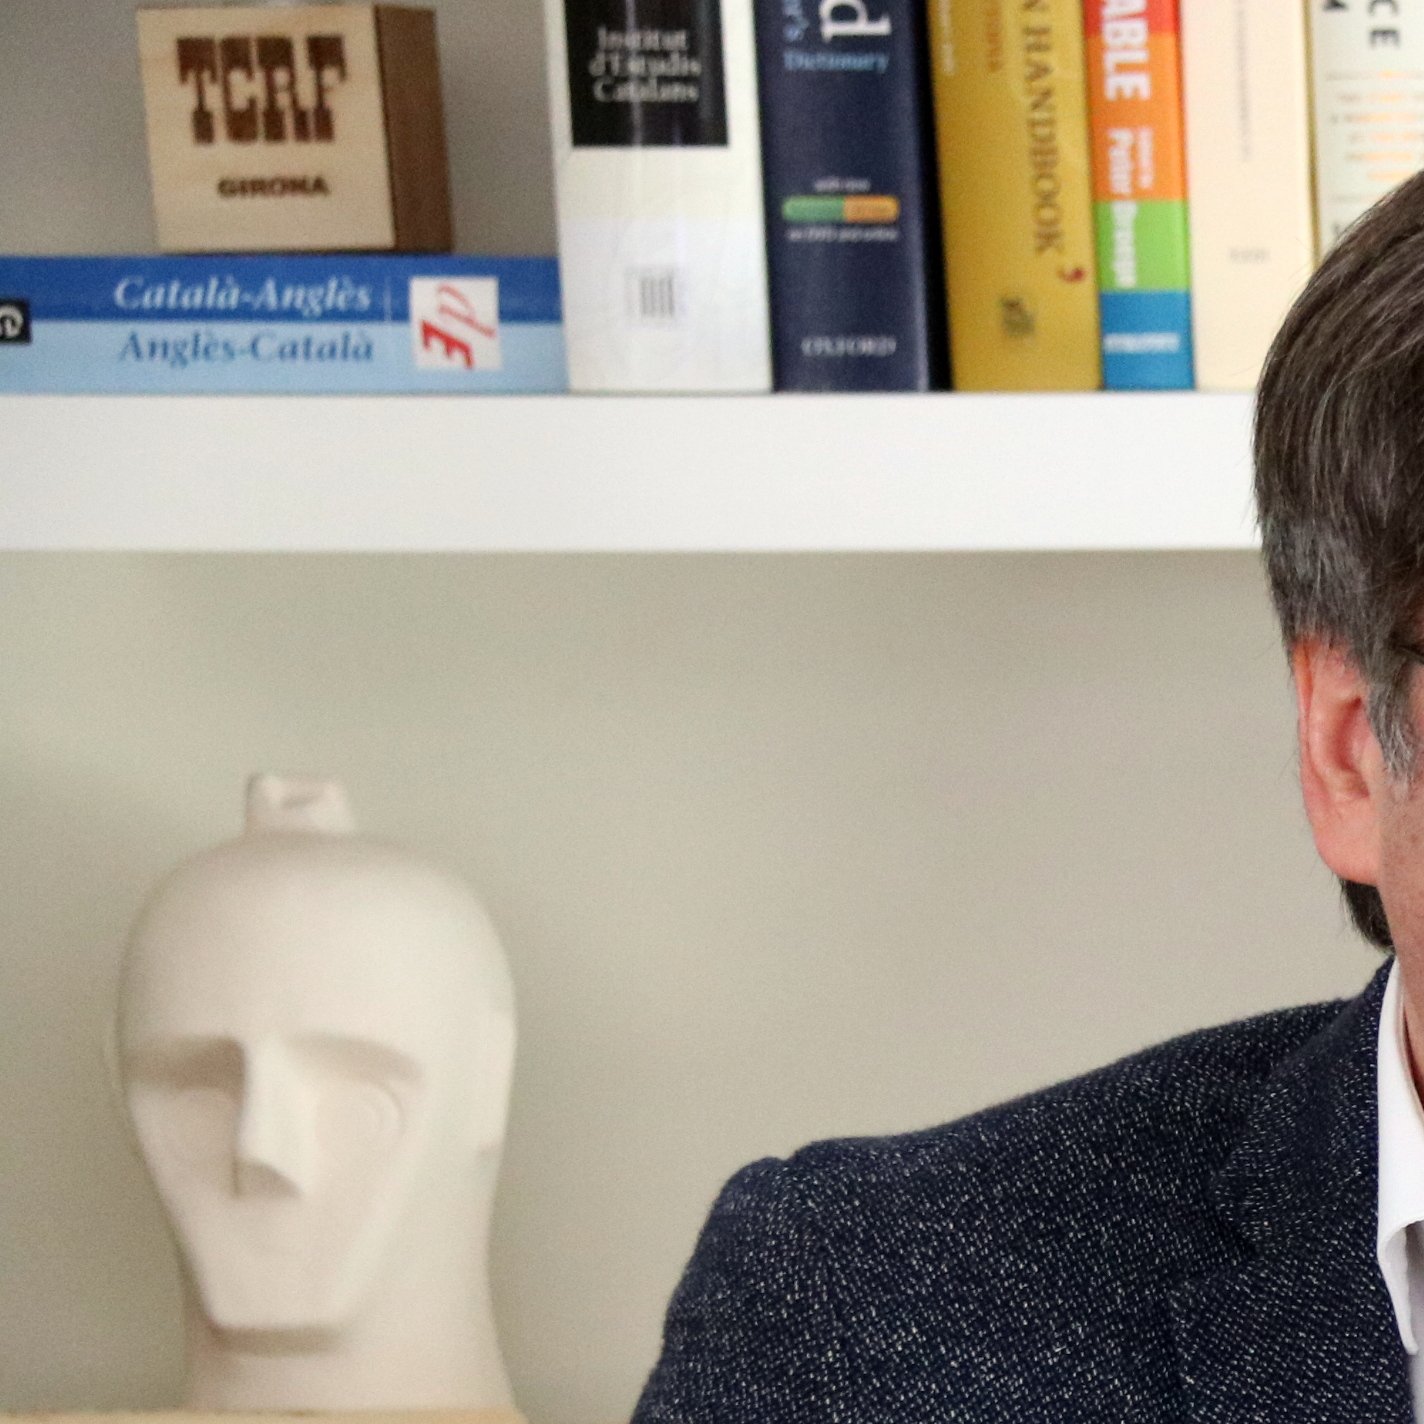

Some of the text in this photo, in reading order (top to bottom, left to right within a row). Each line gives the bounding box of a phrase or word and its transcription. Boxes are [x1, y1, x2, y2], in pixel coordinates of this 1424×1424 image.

[1023, 26, 1064, 256] HANDBOOK
[217, 176, 329, 197] GIRONA
[114, 274, 373, 319] Català-Anglès
[118, 331, 374, 368] Anglès-Català
